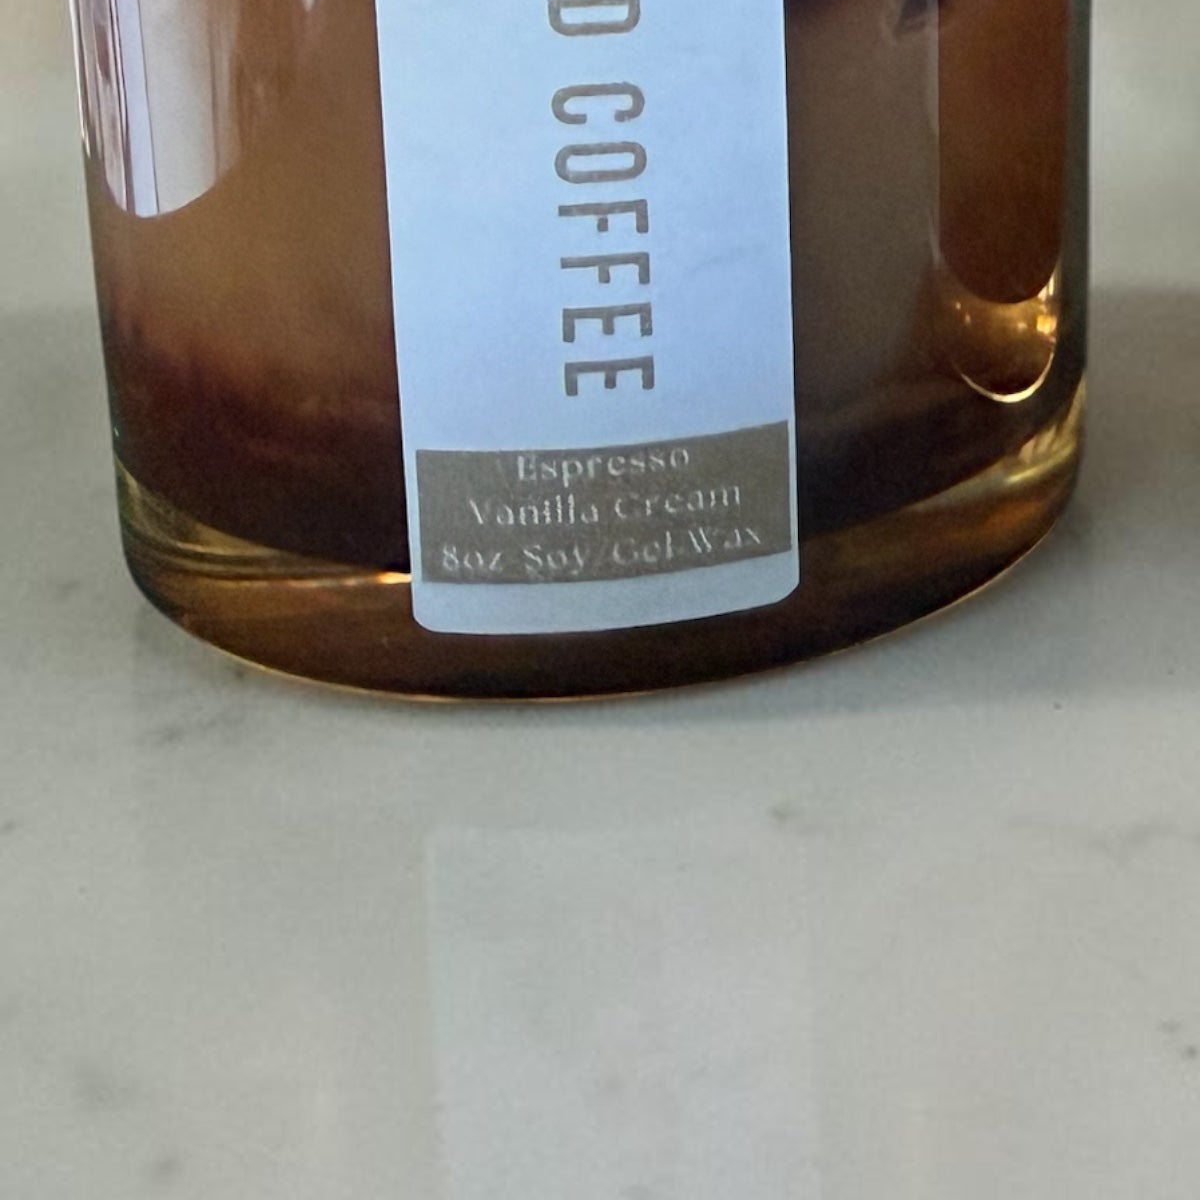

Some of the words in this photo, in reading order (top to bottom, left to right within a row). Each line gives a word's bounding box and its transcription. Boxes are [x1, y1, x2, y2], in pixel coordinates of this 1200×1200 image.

[551, 81, 654, 396] COFFEE
[516, 447, 691, 487] Espresso
[467, 494, 599, 526] Vanilla
[614, 485, 741, 519] Cream
[441, 544, 503, 572] 8oz
[687, 526, 762, 552] Wax
